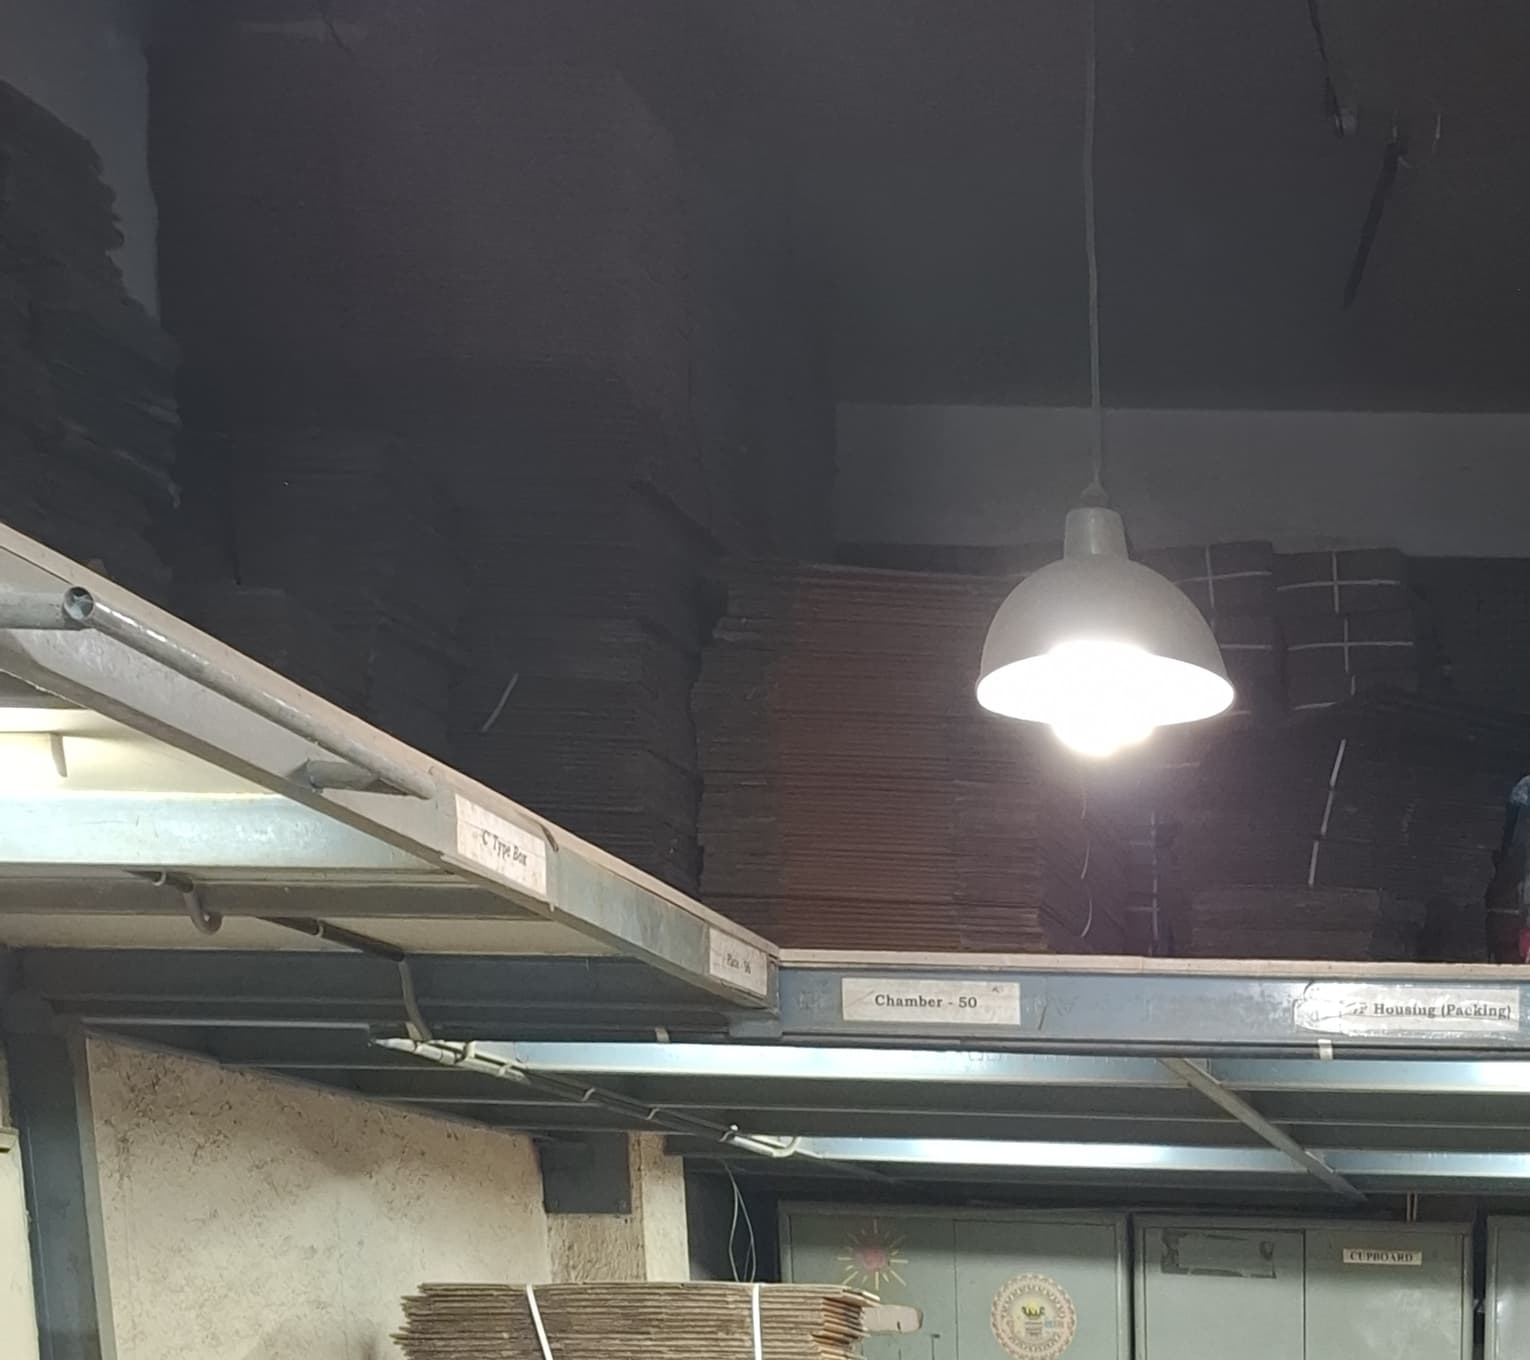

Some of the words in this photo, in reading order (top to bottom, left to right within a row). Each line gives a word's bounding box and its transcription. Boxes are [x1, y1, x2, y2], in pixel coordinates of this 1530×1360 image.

[492, 833, 511, 862] Type
[512, 844, 529, 866] Box
[875, 994, 943, 1008] Chamber
[958, 996, 978, 1009] 50
[1374, 1003, 1436, 1018] Housing
[1440, 1002, 1512, 1020] (Packing)
[1350, 1251, 1413, 1263] CUPBOARD
